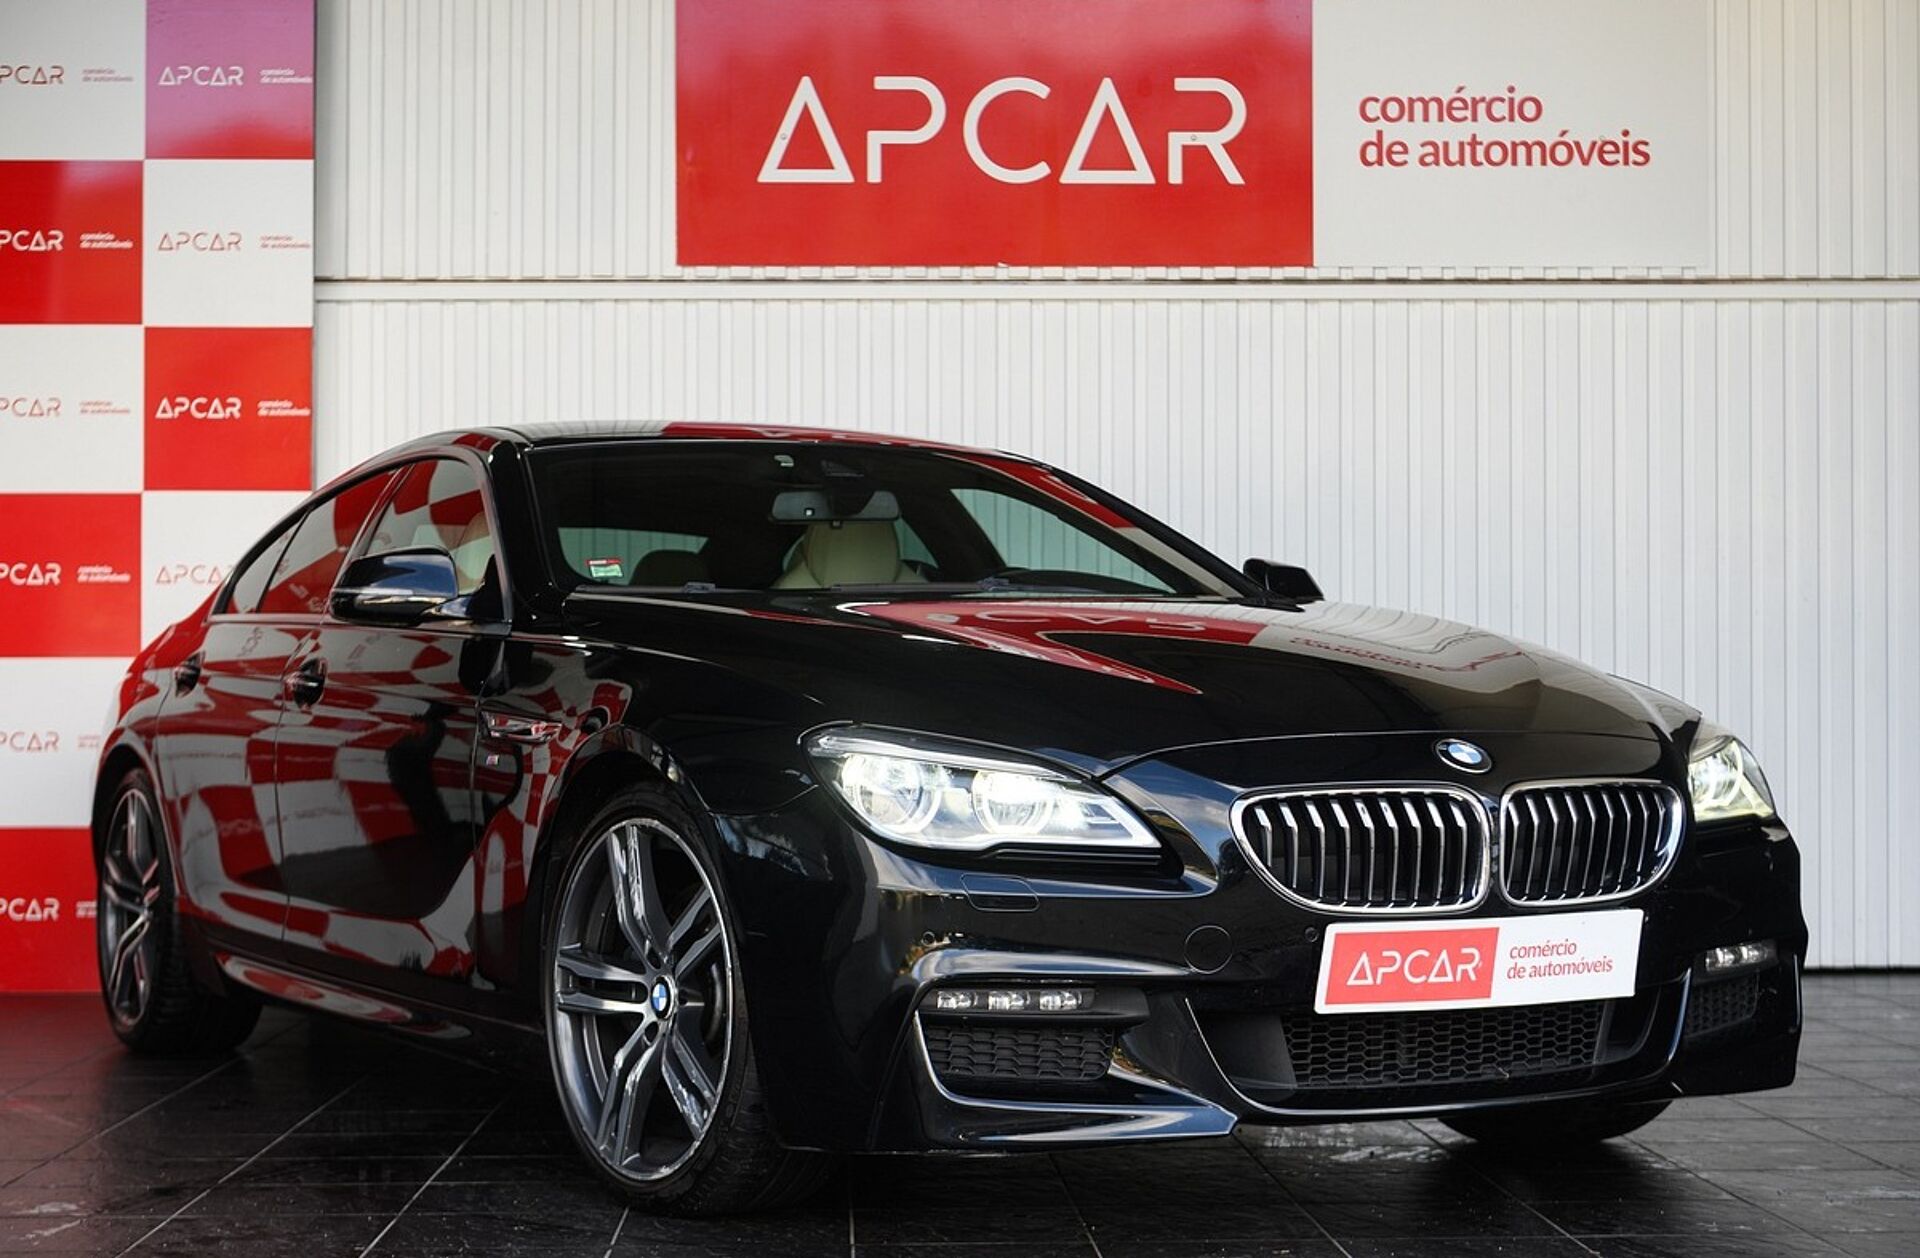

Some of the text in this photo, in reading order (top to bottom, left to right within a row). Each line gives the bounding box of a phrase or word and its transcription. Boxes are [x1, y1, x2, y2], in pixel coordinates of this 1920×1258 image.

[158, 65, 244, 87] APCAR
[1359, 86, 1543, 124] comércio
[758, 76, 1247, 185] APCAR
[1360, 129, 1651, 167] de automóveis
[157, 231, 242, 251] APCAR
[155, 396, 242, 420] APCAR
[156, 565, 230, 585] APCA
[1509, 939, 1578, 960] comércio
[1346, 947, 1480, 986] APCAR
[1507, 955, 1613, 980] de automóveis
